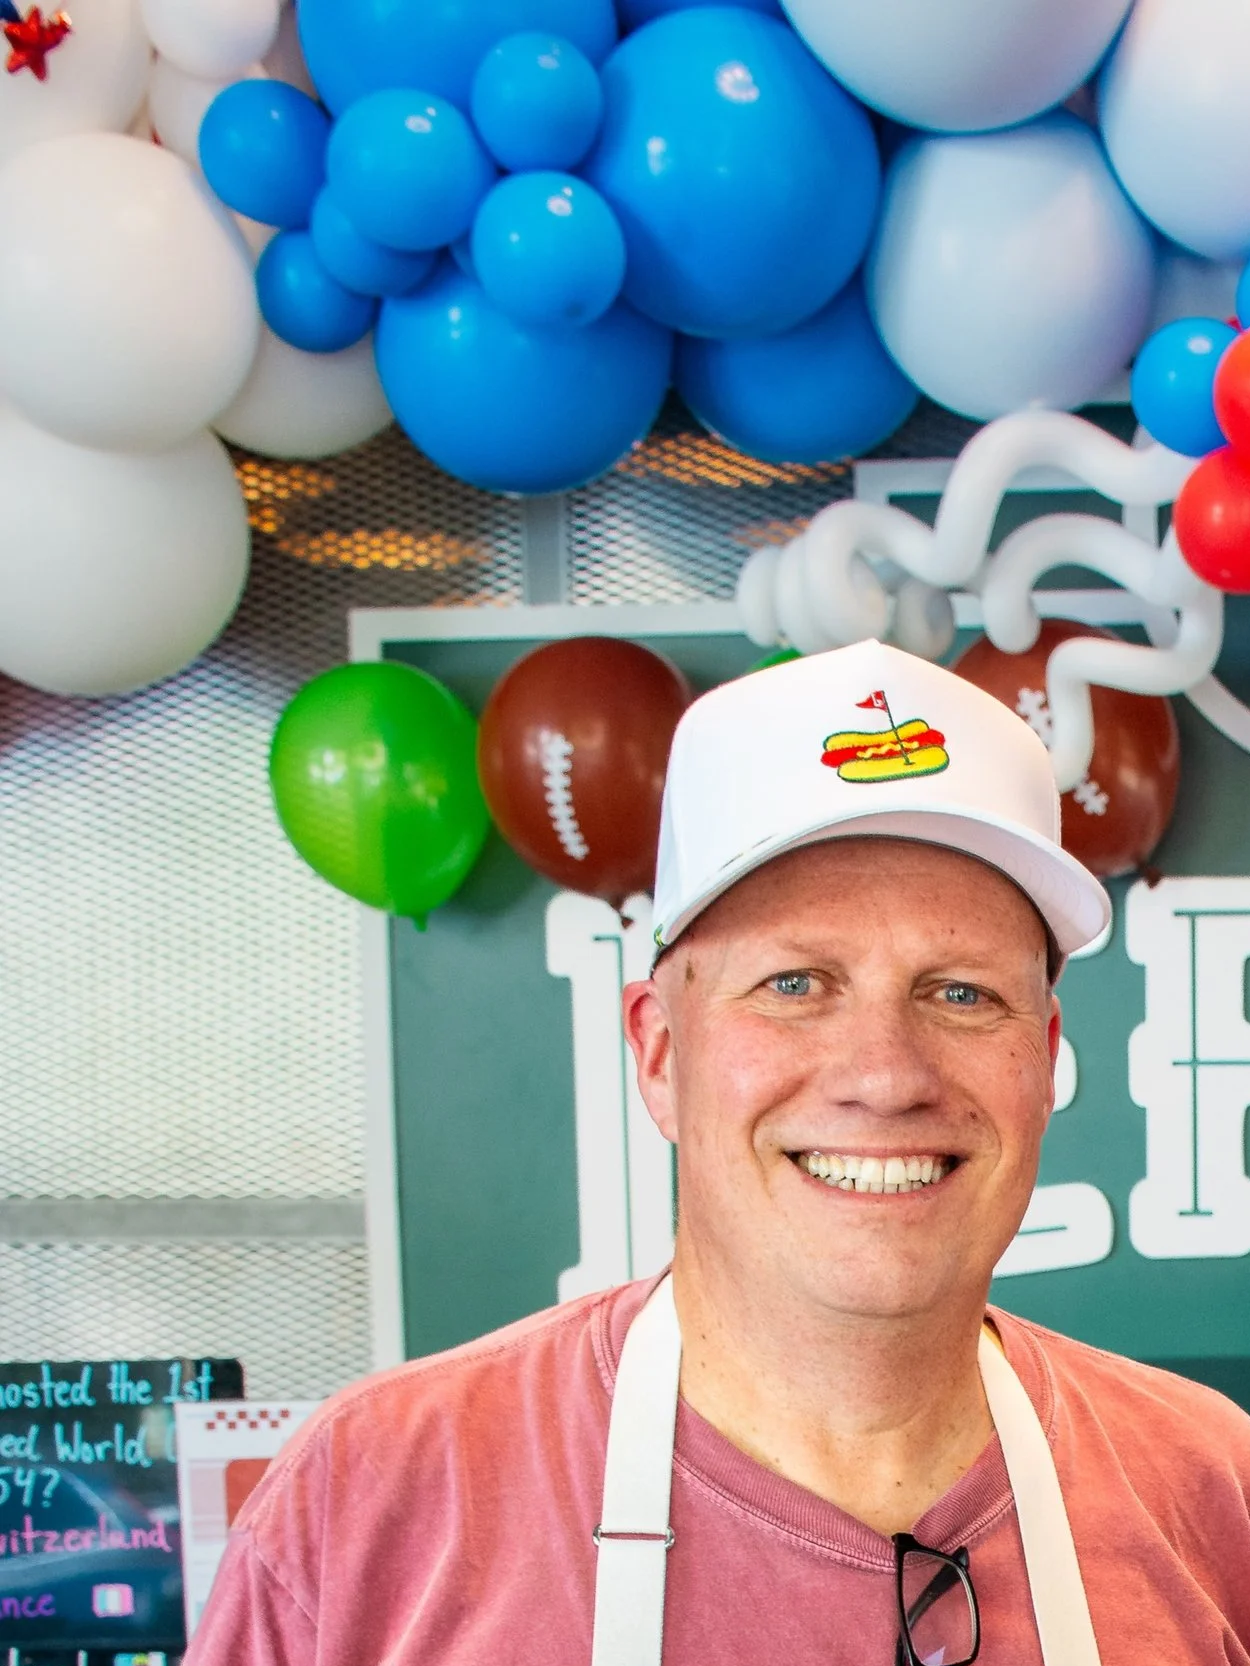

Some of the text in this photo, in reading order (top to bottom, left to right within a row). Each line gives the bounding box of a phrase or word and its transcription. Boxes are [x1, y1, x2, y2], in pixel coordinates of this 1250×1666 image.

[107, 1362, 153, 1404] the
[163, 1361, 214, 1403] 1st
[54, 1421, 152, 1468] World
[0, 1594, 56, 1619] nce
